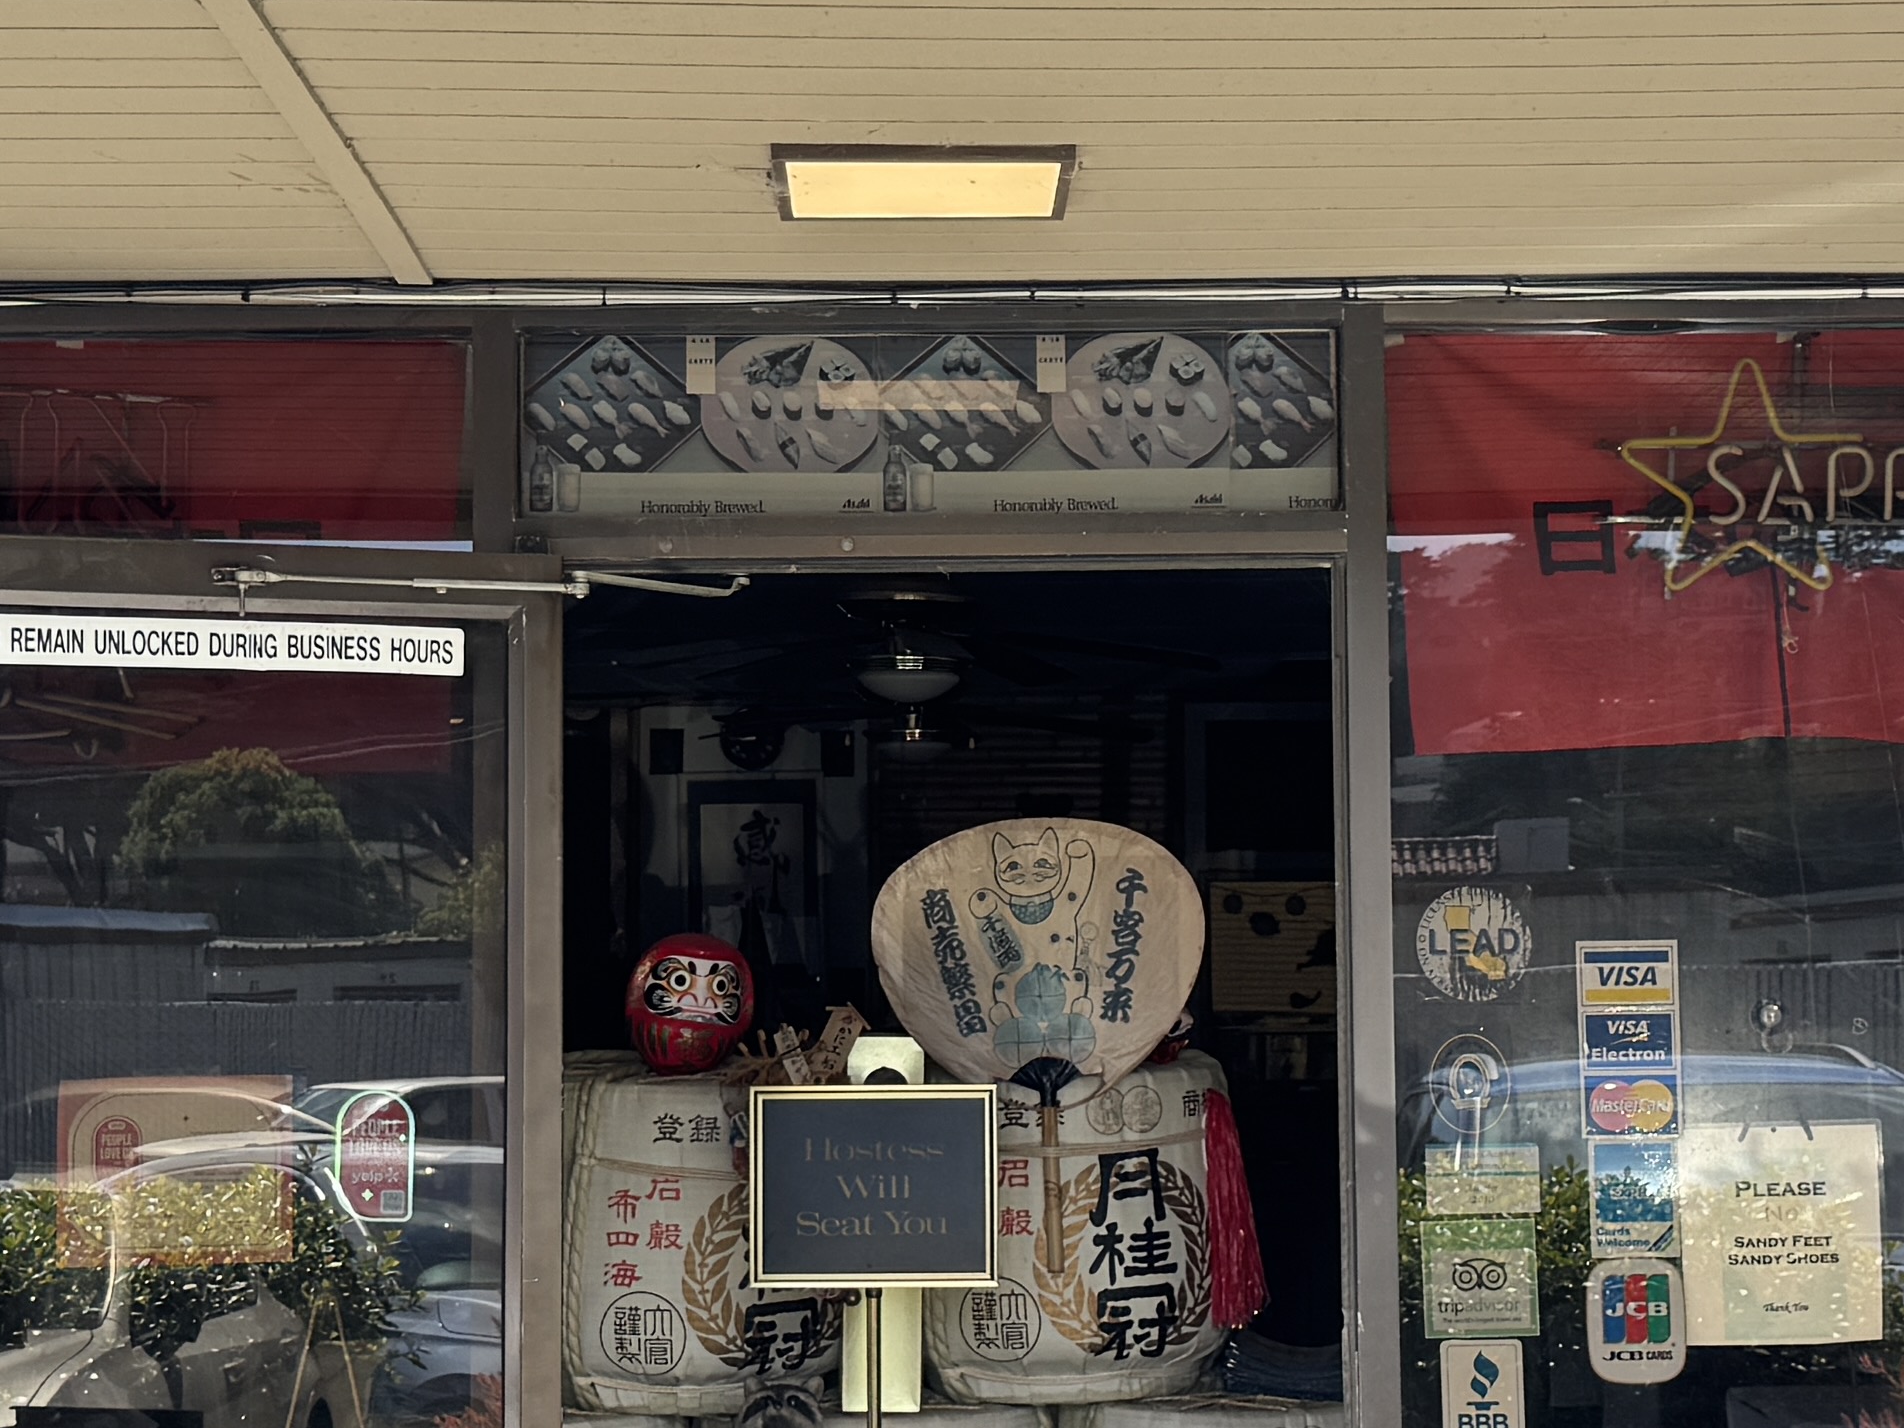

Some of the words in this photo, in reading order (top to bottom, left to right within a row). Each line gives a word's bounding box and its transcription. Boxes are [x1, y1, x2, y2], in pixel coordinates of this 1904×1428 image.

[641, 500, 711, 517] Honorably
[994, 498, 1063, 515] Honorably
[10, 626, 84, 655] REMAIN
[94, 628, 199, 657] UNLOCKED
[209, 630, 278, 660] DURING
[287, 633, 381, 662] BUSINESS
[390, 636, 454, 665] HOURS
[1429, 927, 1521, 957] LEAD
[1597, 965, 1658, 987] VISA
[1607, 1020, 1651, 1035] VISA
[1591, 1047, 1666, 1062] Electron
[1591, 1097, 1671, 1114] MasterCard
[804, 1137, 945, 1162] Hostess
[351, 1171, 384, 1185] yelp
[836, 1175, 911, 1199] Will
[1735, 1180, 1827, 1198] PLEASE
[796, 1210, 875, 1237] Seat
[883, 1210, 948, 1236] You
[1733, 1236, 1788, 1248] SANDY
[1792, 1235, 1833, 1247] FEET
[1089, 1147, 1179, 1361] 月桂冠
[1728, 1253, 1783, 1265] SANDY
[1786, 1252, 1840, 1265] SHOES
[1437, 1298, 1521, 1316] tripadvisor
[1604, 1301, 1669, 1320] JCB
[1602, 1350, 1645, 1361] JCB
[1646, 1350, 1674, 1361] CARDS
